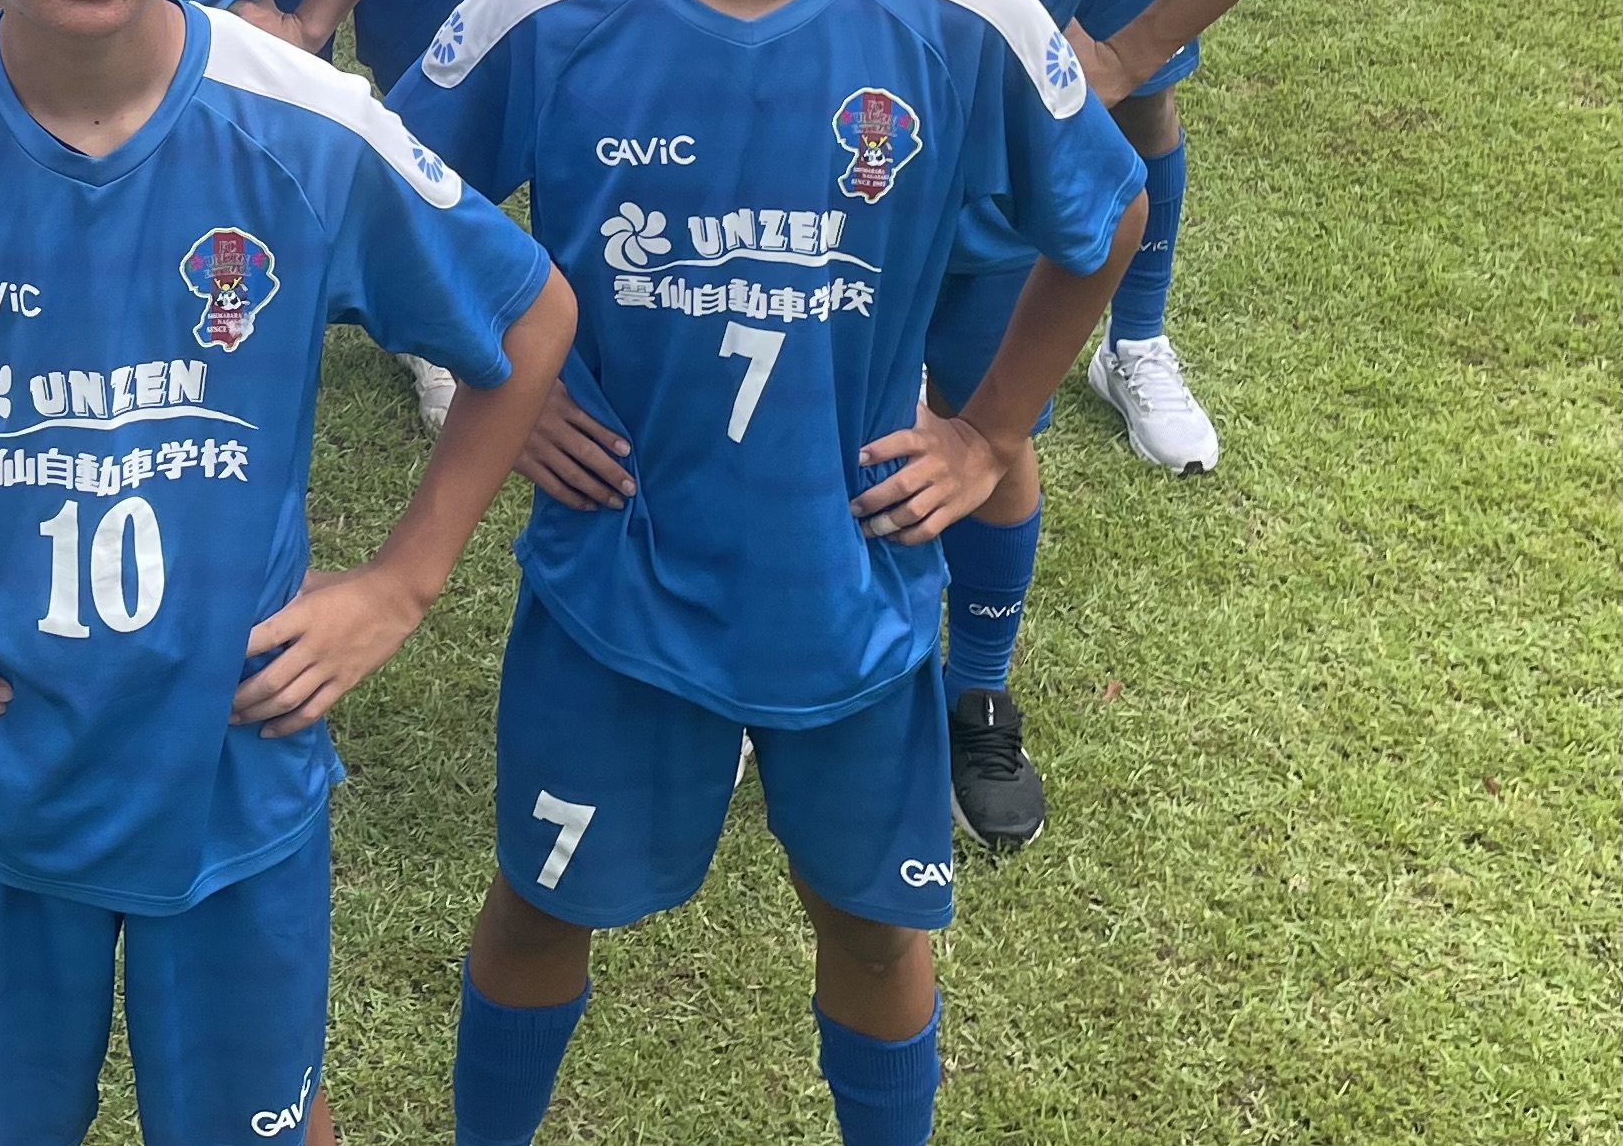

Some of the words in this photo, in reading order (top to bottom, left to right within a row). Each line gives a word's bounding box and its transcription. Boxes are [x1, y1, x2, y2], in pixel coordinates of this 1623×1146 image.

[596, 135, 697, 166] GAViC
[688, 208, 847, 258] UNZEN
[612, 274, 876, 323] 雲仙自動車学校
[30, 360, 207, 419] UNZEN
[719, 321, 786, 443] 7
[37, 496, 165, 639] 10
[532, 789, 596, 890] 7
